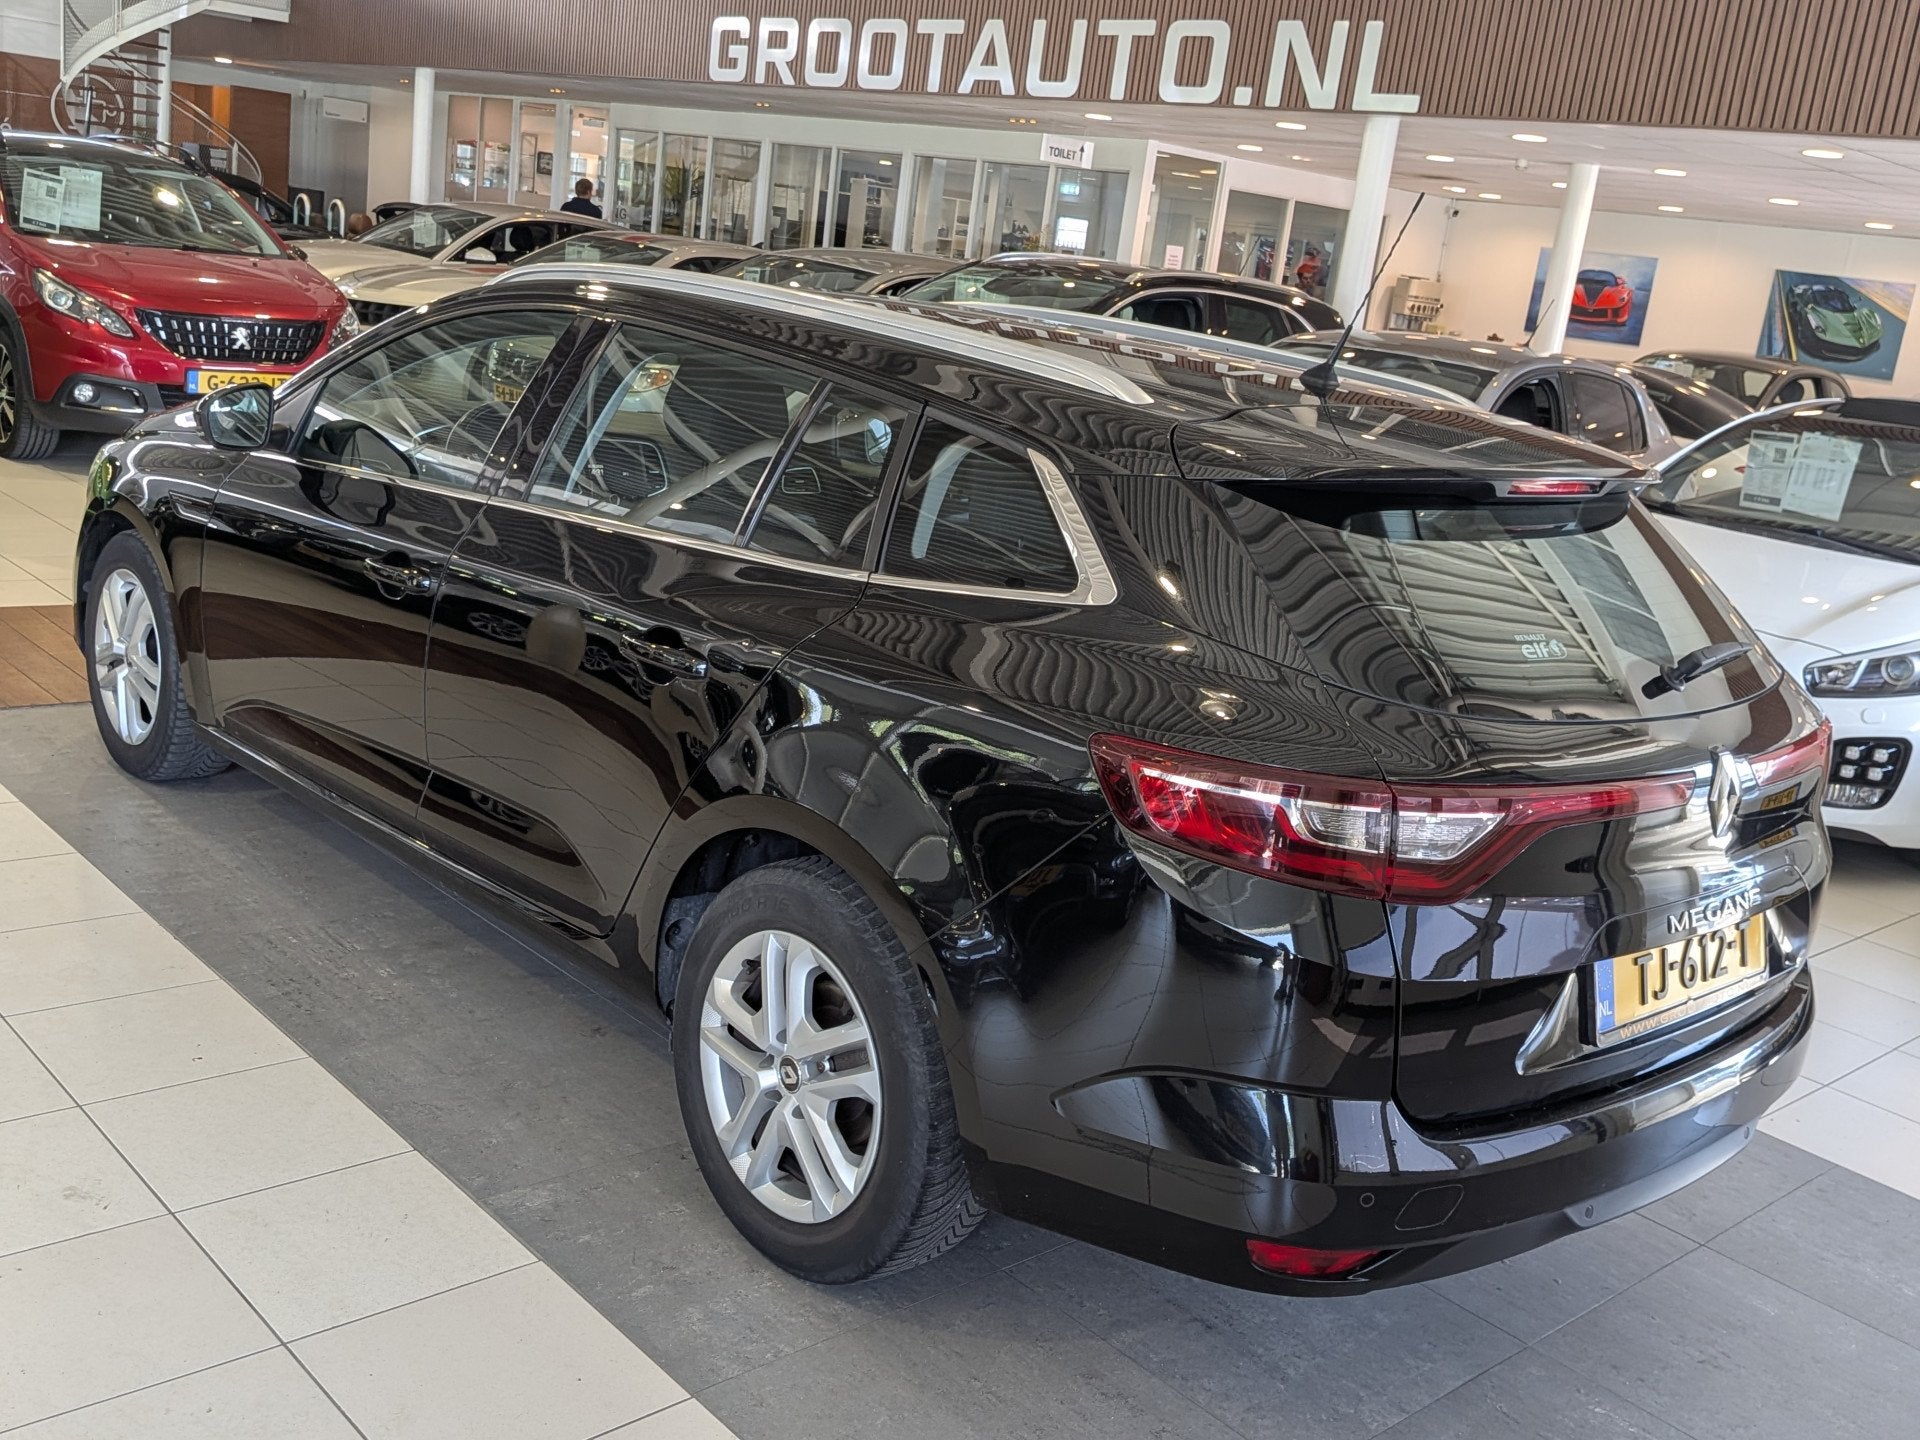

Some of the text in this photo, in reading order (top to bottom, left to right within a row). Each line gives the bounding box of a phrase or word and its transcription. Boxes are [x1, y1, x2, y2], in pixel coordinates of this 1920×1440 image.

[708, 16, 1421, 113] GROOTAUTO.NL
[1049, 146, 1077, 160] TOILET
[1514, 633, 1546, 641] RENAULT
[1521, 641, 1549, 658] elf
[1667, 888, 1761, 934] MEGANE
[1632, 921, 1751, 1005] TJ-612-T
[1599, 1001, 1613, 1018] NL
[1619, 979, 1751, 1039] WWW.GROOUTO.N
